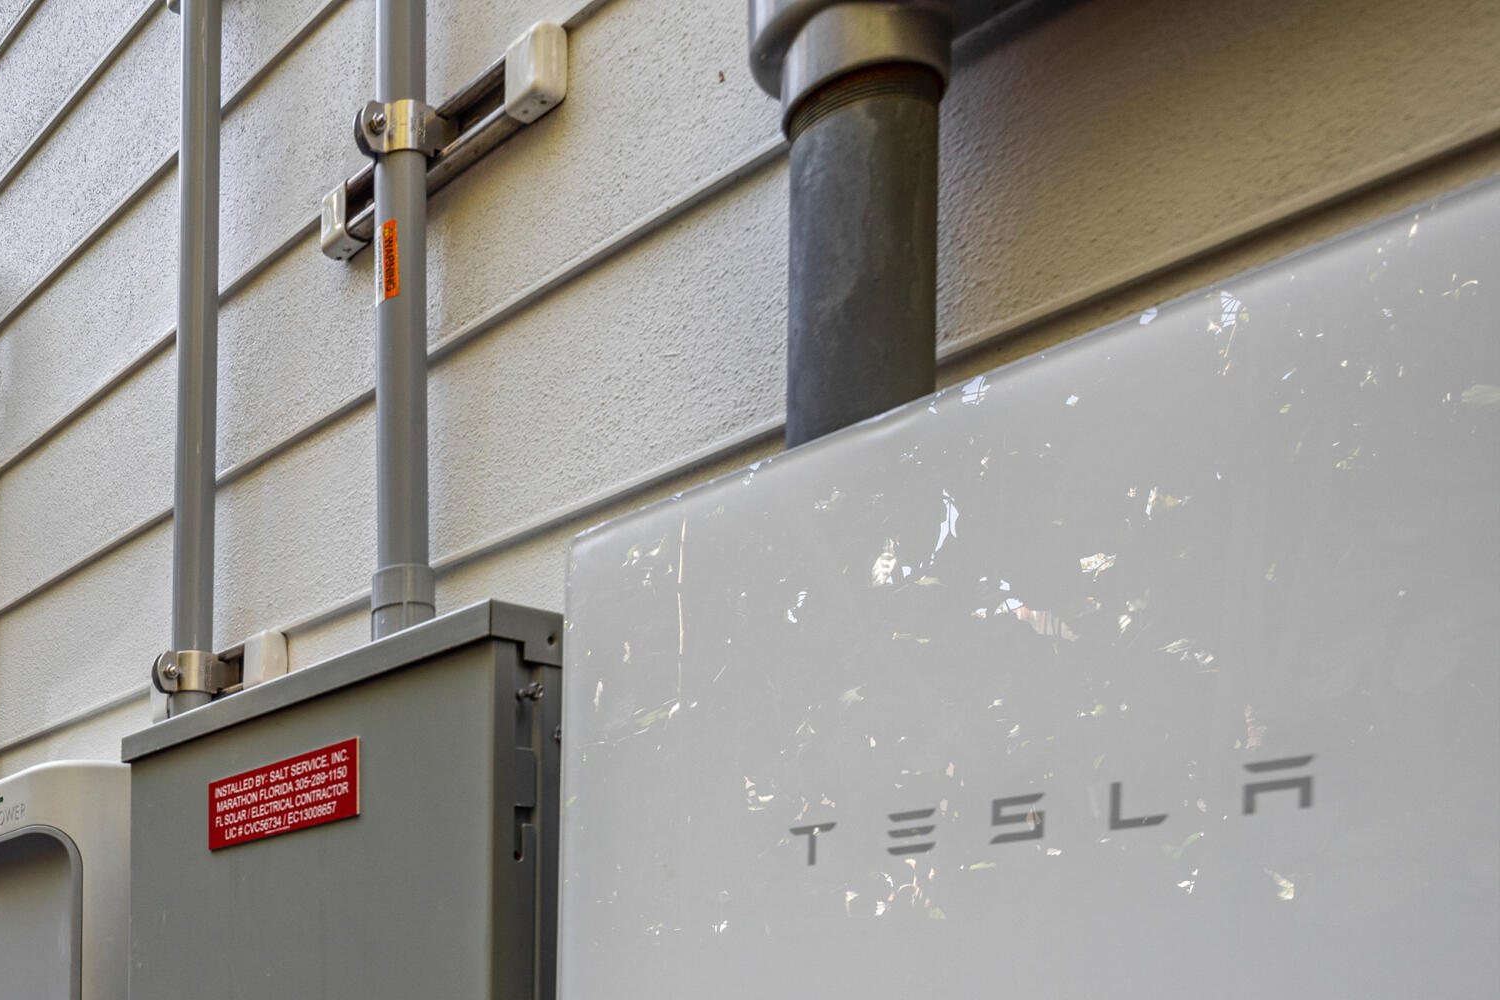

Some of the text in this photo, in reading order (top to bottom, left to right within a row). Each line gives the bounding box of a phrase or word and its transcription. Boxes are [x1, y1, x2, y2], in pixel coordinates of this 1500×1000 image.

[385, 235, 396, 293] WARNING
[215, 748, 350, 799] INSTALLED BY: SALT SERVICE, INC.
[216, 765, 348, 813] MARATHON FLORIDA 305-289-1150
[215, 816, 224, 828] FL
[224, 809, 247, 826] SOLAR
[251, 796, 294, 819] ELECTRICAL
[295, 781, 349, 807] CONTRACTOR
[789, 754, 1316, 867] TESLA
[225, 827, 237, 840] LIC
